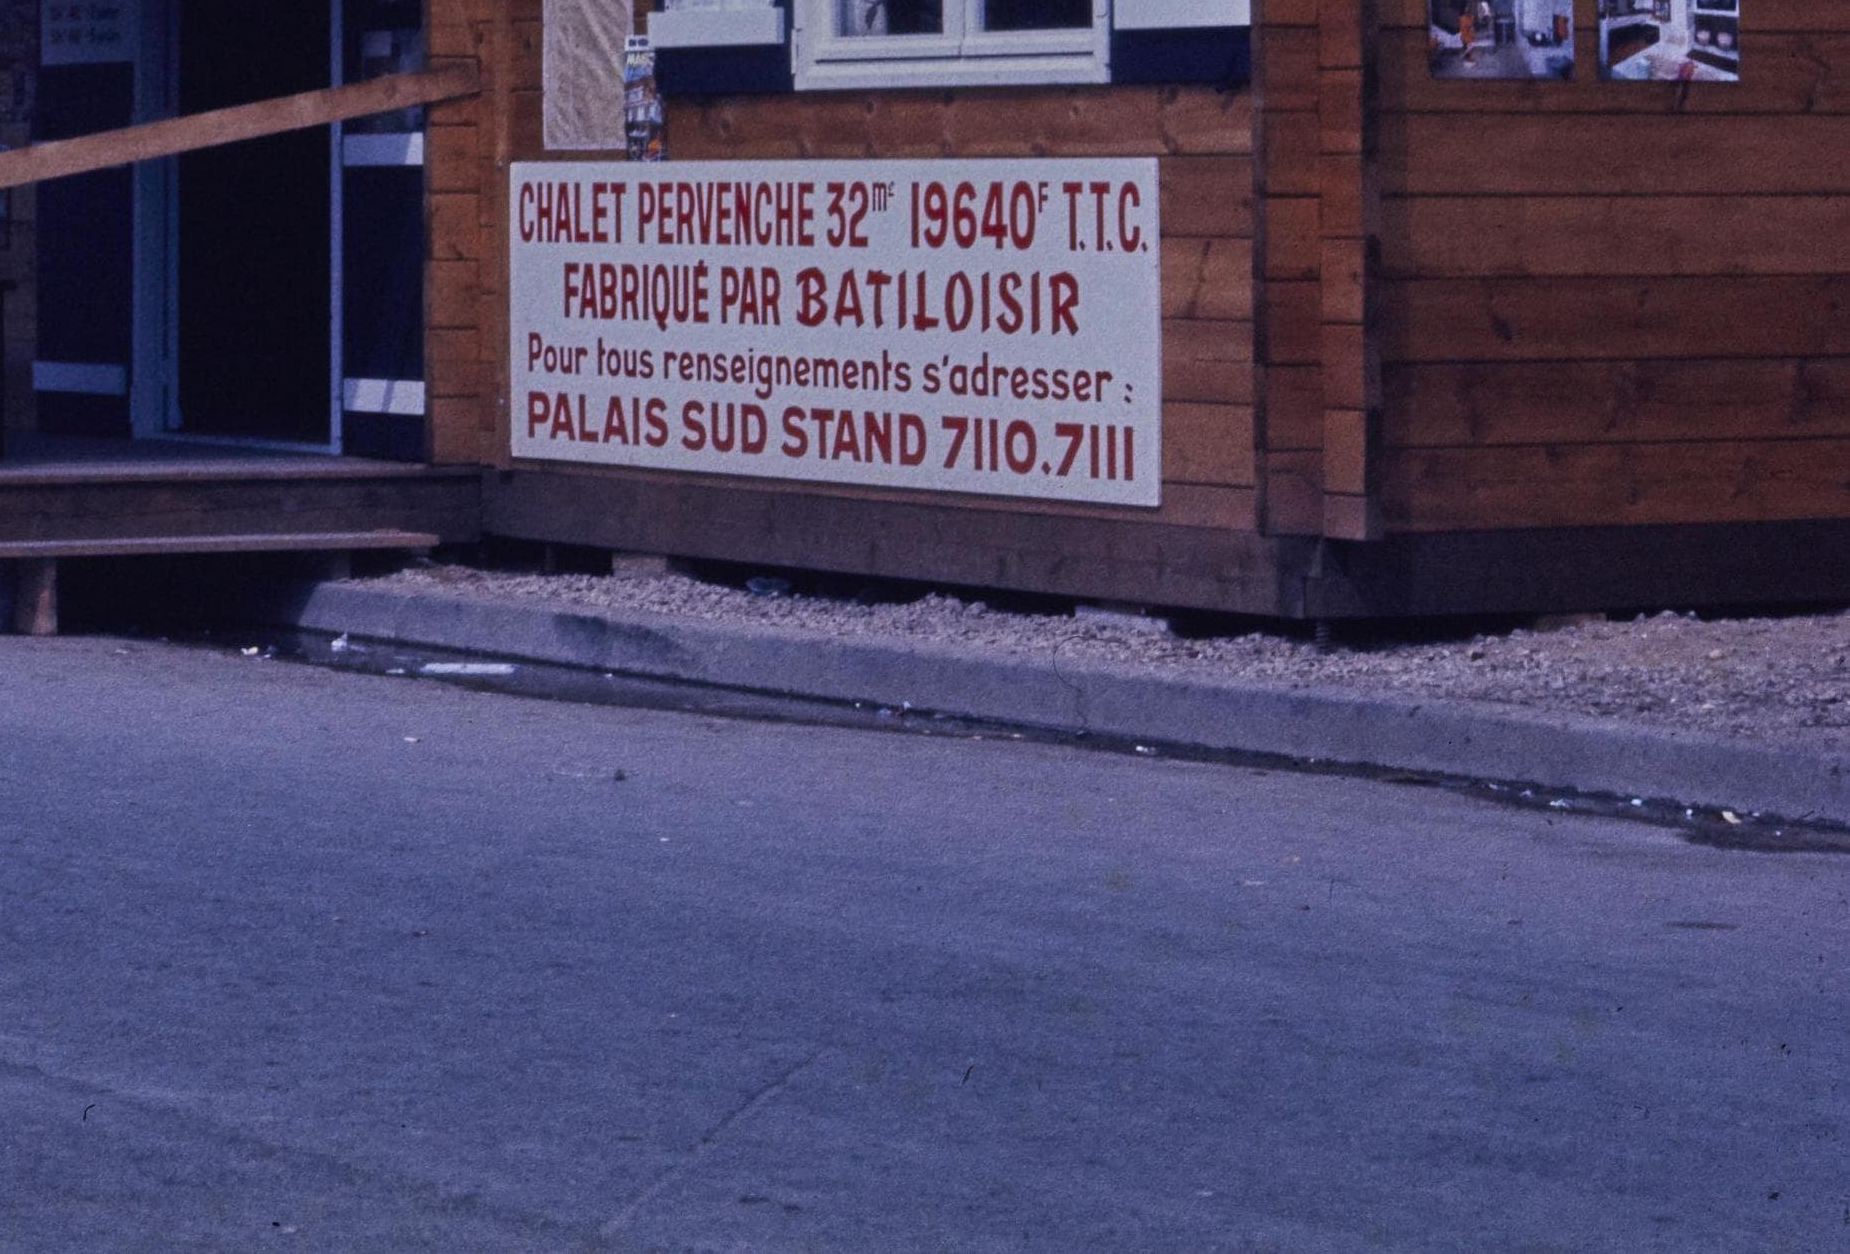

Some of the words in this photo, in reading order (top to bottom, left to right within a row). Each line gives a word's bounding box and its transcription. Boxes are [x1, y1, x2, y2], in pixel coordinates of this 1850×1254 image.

[518, 181, 626, 244] CHALET
[637, 181, 815, 247] PERVENCHE
[563, 258, 710, 332] FABRIQUÉ
[720, 265, 782, 326] PAR
[795, 265, 1080, 336] BATILOISIR
[527, 331, 589, 376] Pour
[597, 336, 655, 380] tous
[662, 347, 912, 400] renseignements
[527, 390, 670, 448] PALAIS
[681, 399, 768, 455] SUD
[780, 405, 928, 468] STAND
